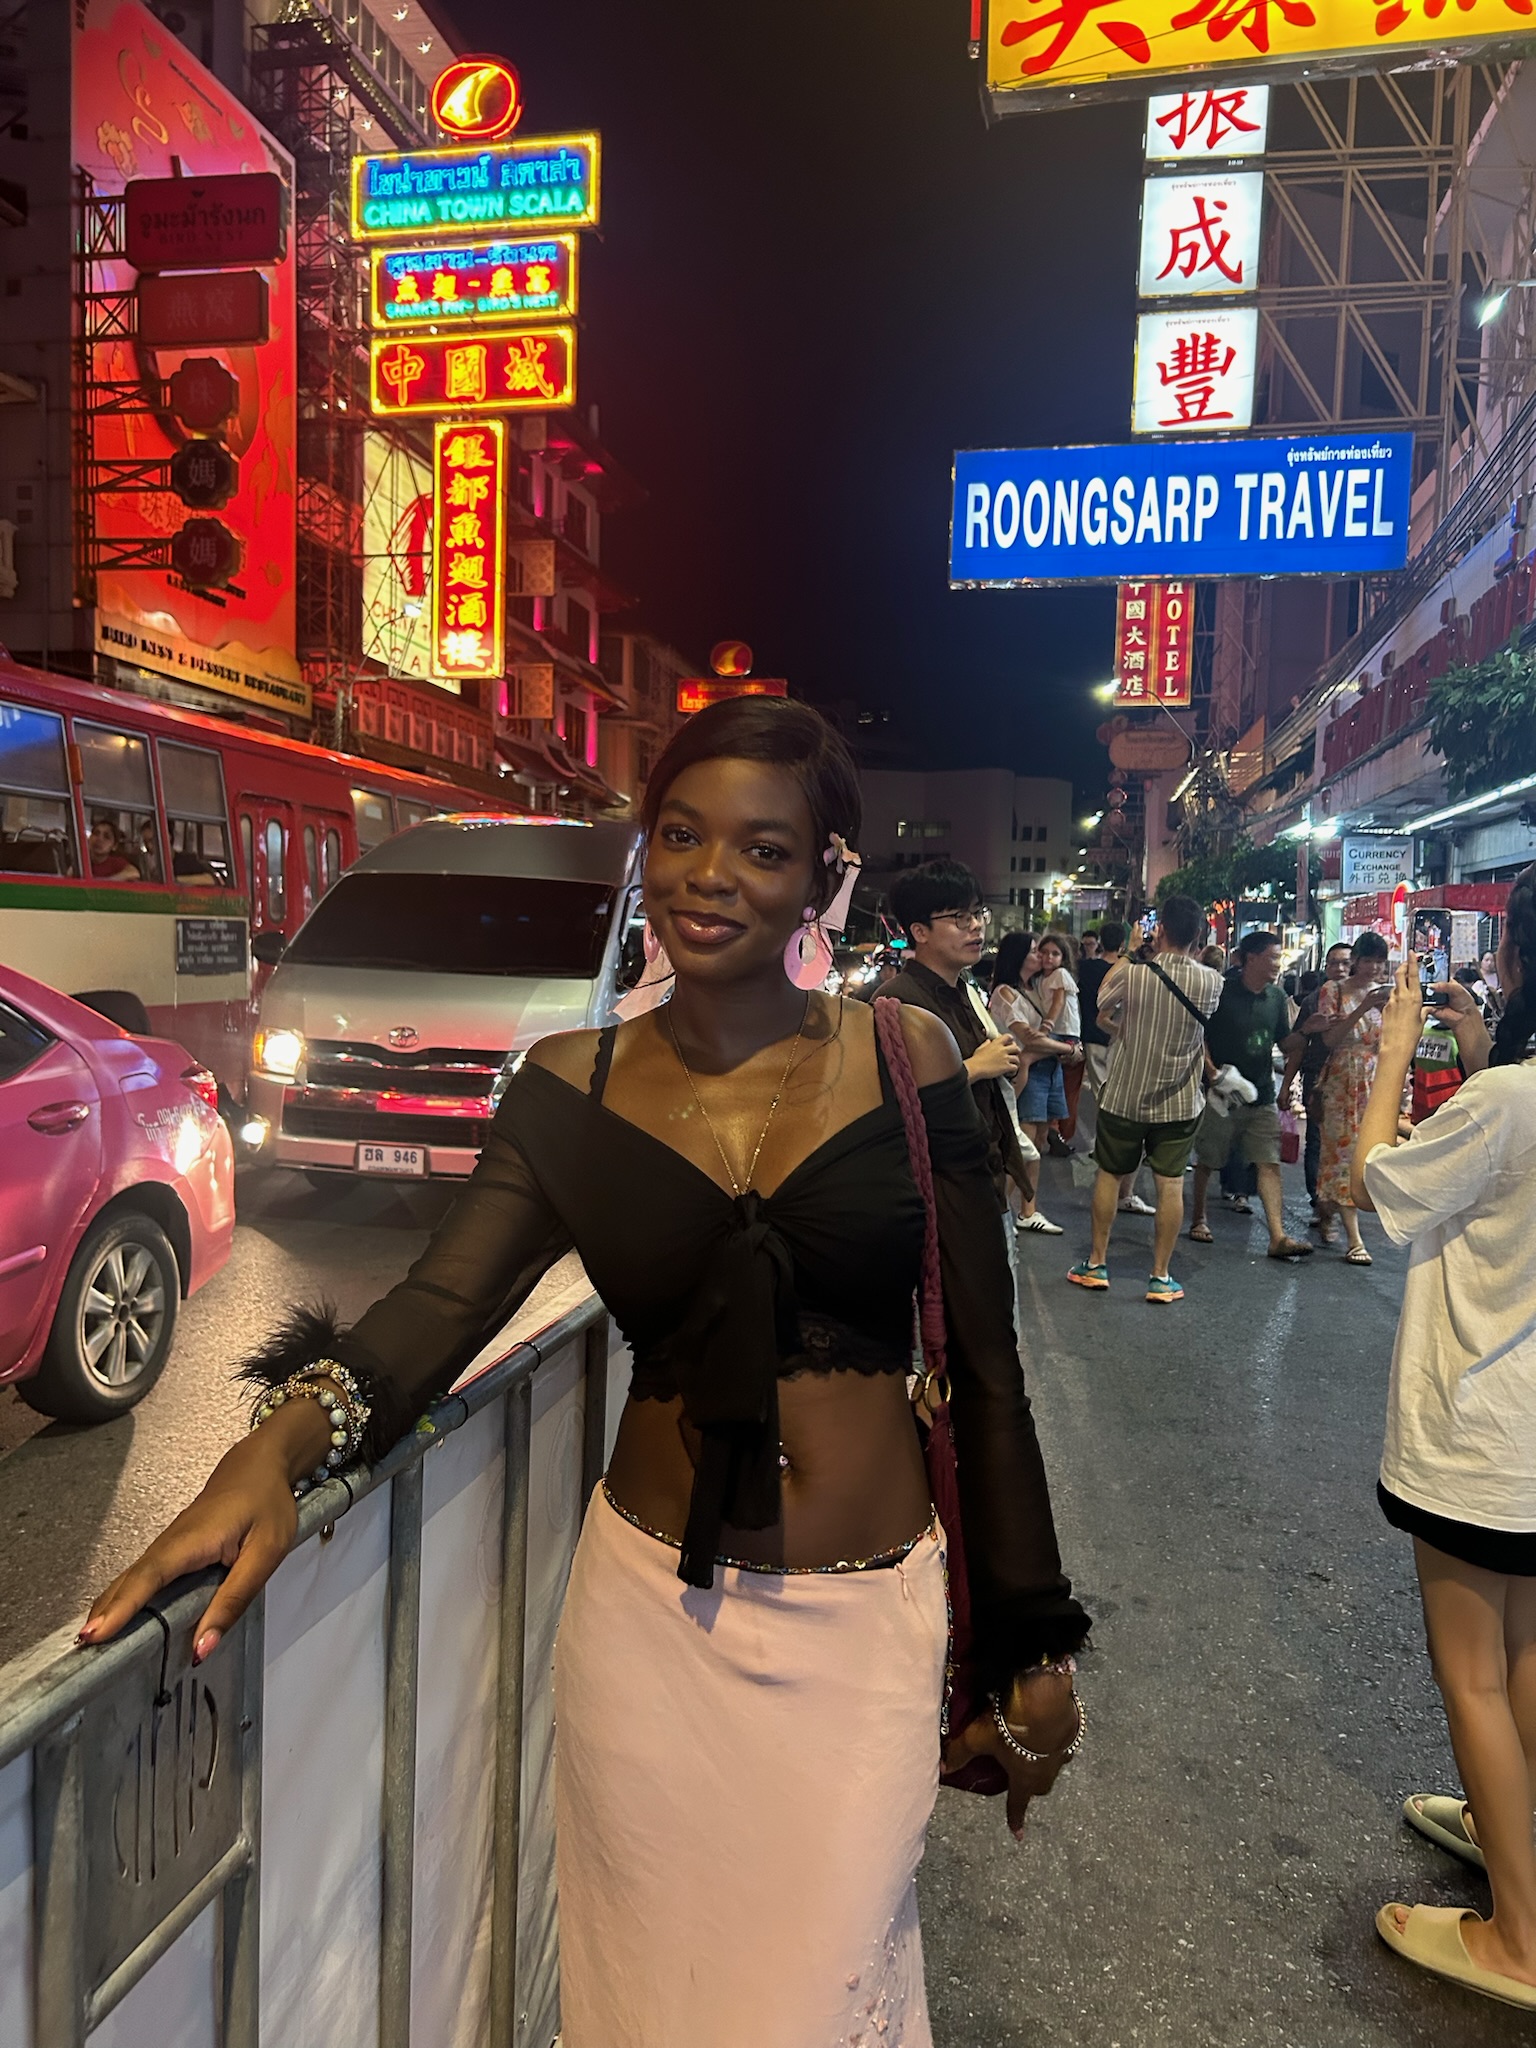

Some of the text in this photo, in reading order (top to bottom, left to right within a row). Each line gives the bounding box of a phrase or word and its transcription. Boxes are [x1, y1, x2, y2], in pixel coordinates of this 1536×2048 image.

[364, 189, 584, 227] CHINA TOWN SCALA
[523, 291, 559, 310] NEST
[382, 337, 555, 407] 中國城
[965, 468, 1394, 549] ROONGSARP TRAVEL
[1348, 848, 1406, 859] CURRENCY
[1353, 862, 1402, 871] EXCHANGE
[394, 1149, 418, 1164] 946
